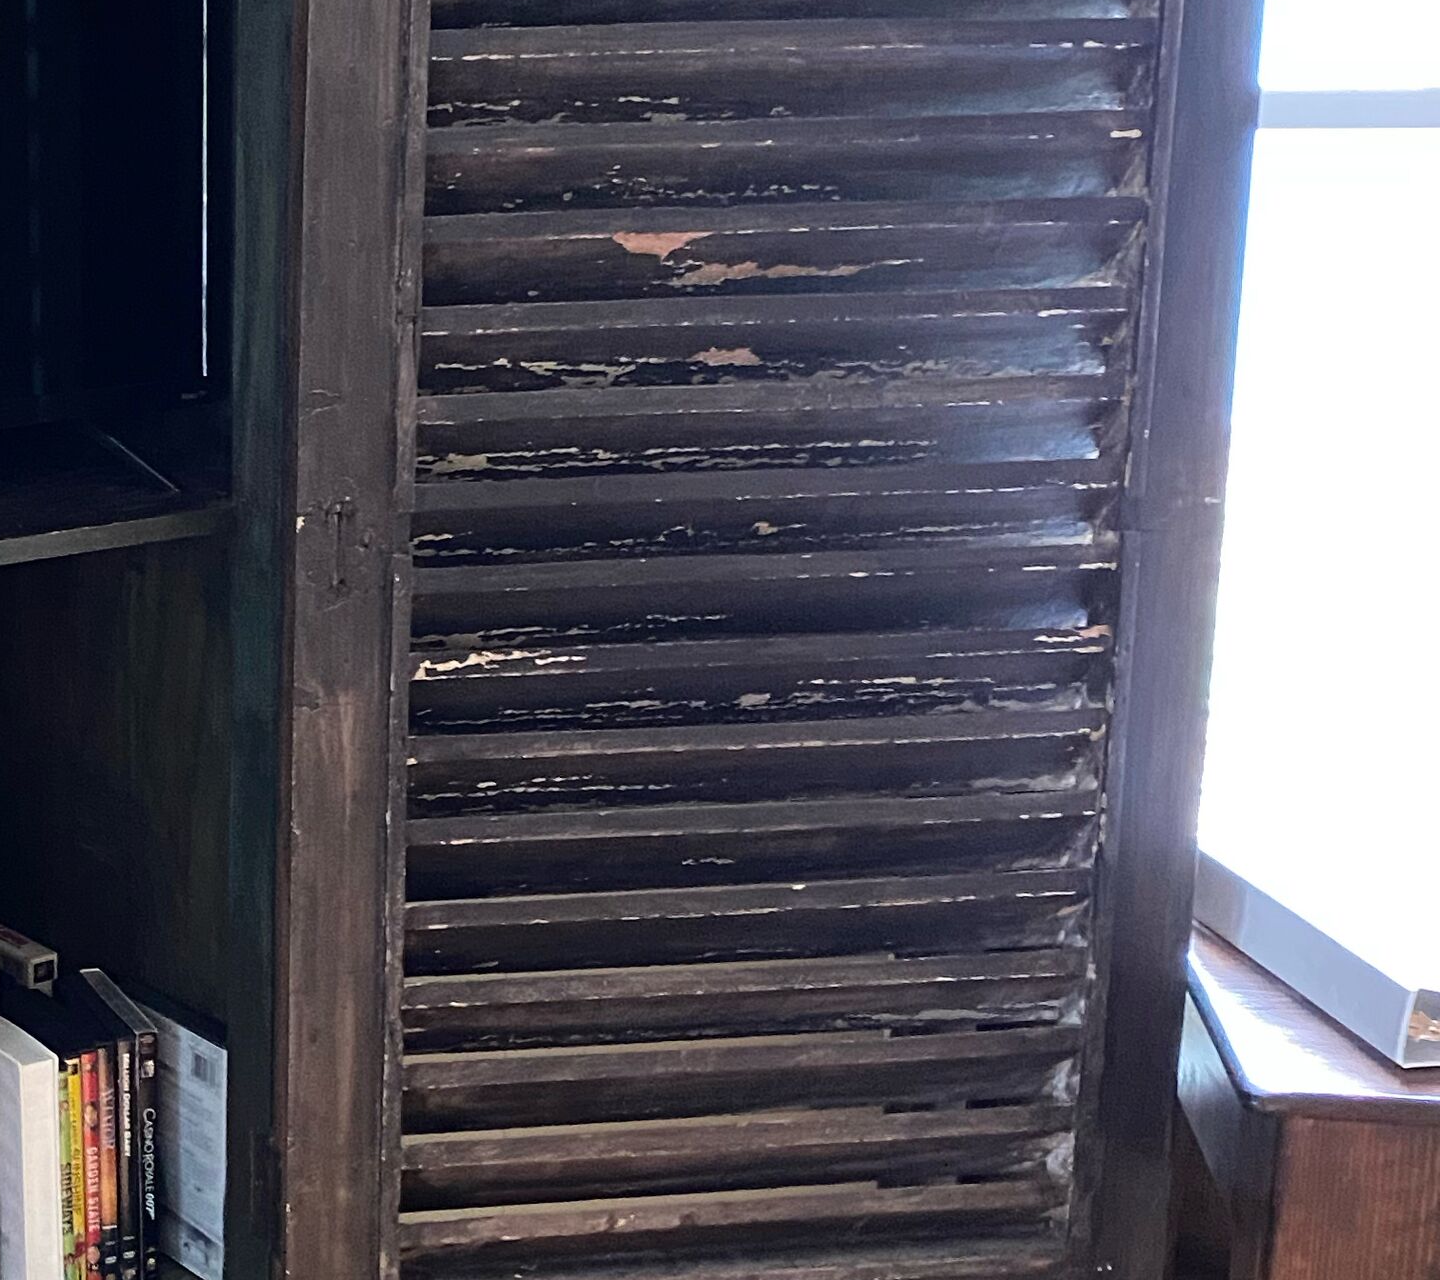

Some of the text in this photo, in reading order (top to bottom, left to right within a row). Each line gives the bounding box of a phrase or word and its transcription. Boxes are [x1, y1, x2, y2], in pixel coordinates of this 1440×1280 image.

[86, 1146, 101, 1233] GARDEN STATE
[143, 1108, 157, 1220] CASINO ROYALE 007
